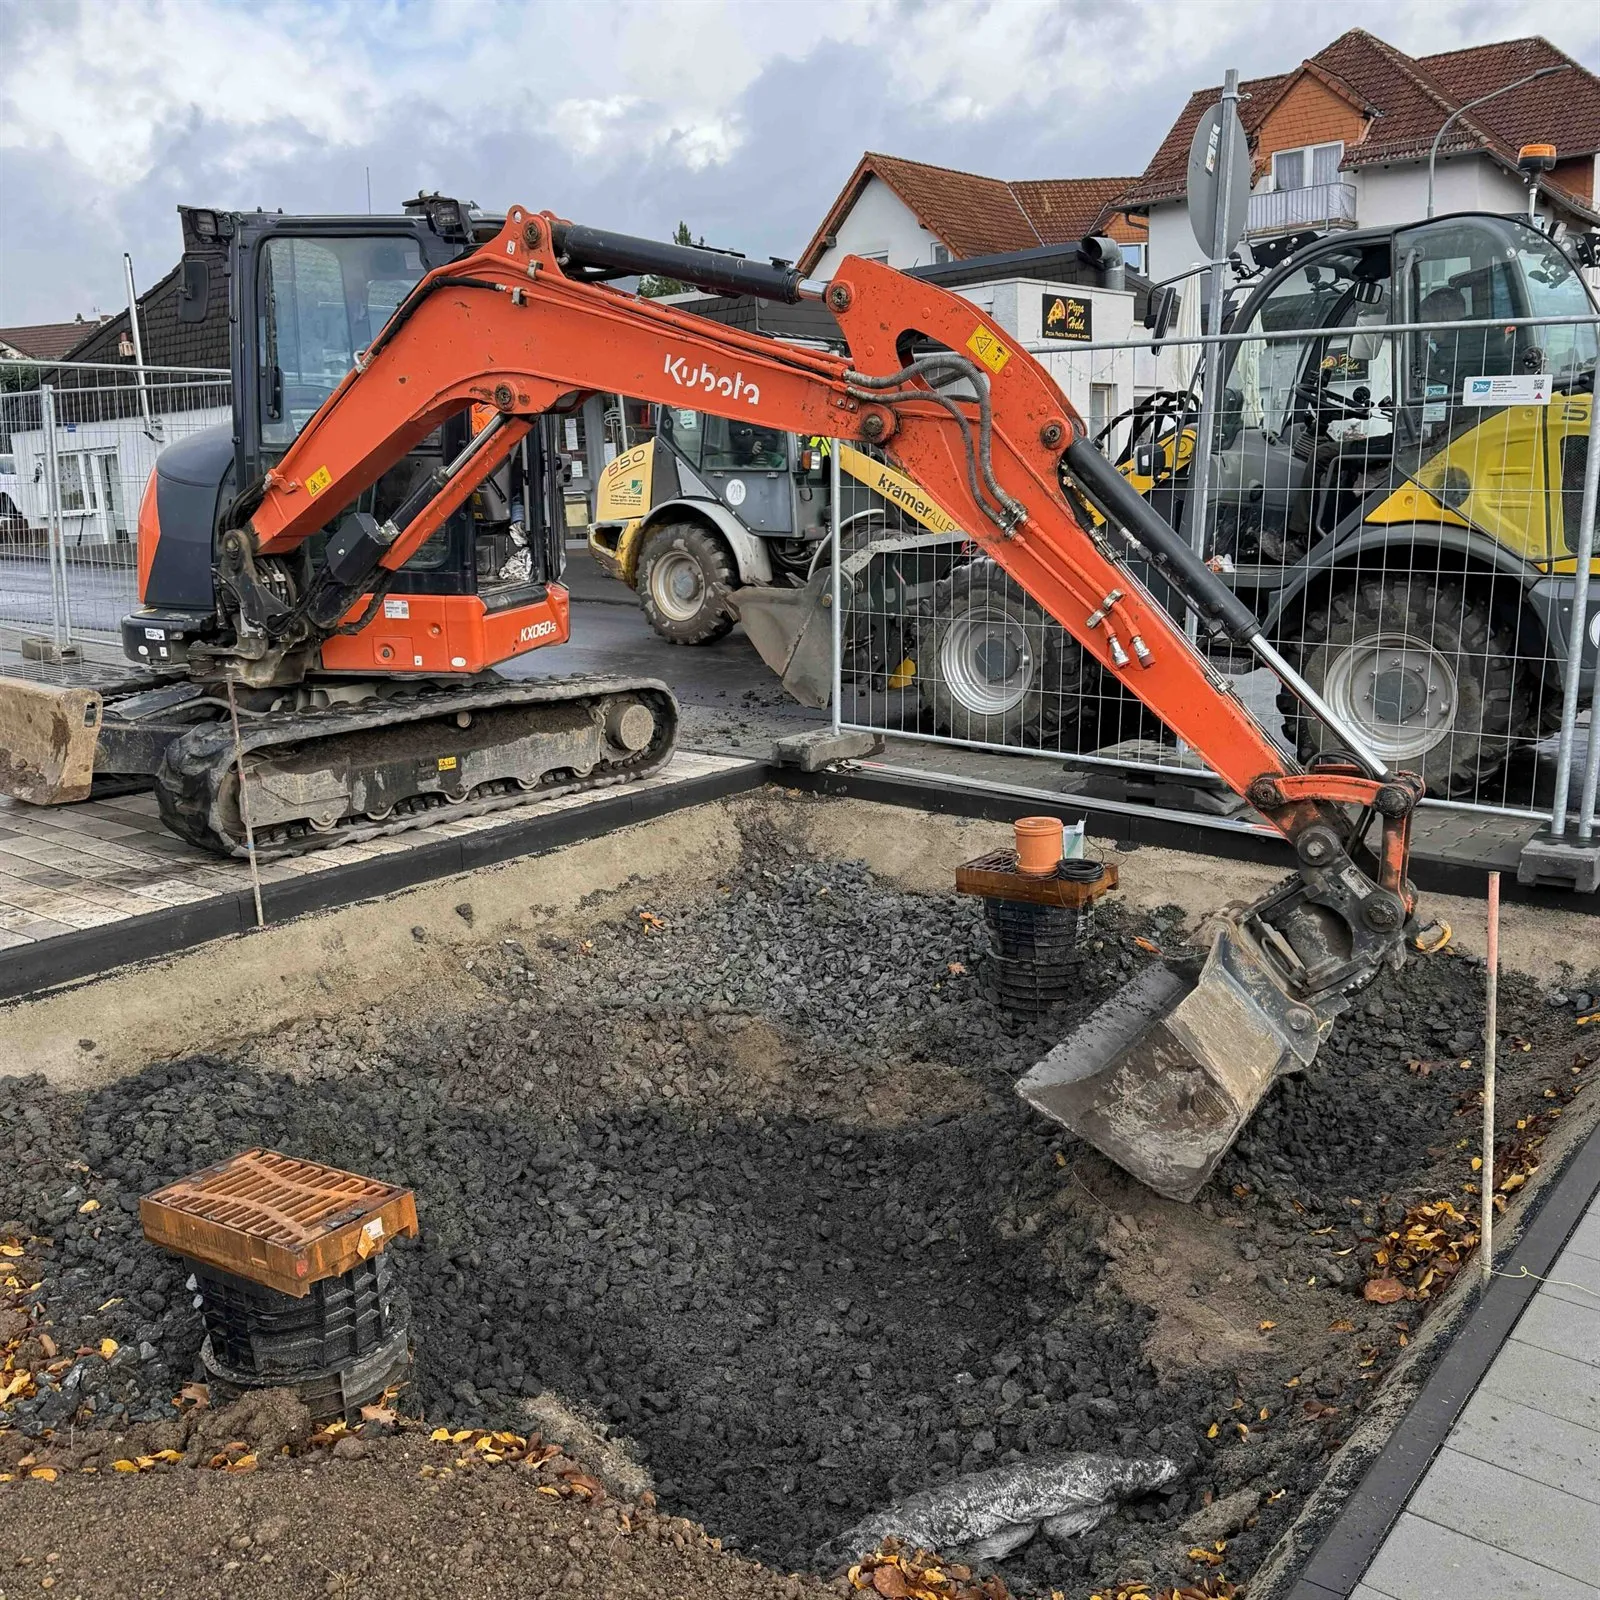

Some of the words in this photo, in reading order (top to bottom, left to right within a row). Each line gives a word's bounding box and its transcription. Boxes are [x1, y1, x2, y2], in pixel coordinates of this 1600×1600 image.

[1068, 299, 1084, 317] Pizza
[1068, 316, 1085, 330] Held
[664, 353, 760, 405] Kubota
[608, 450, 645, 477] 850
